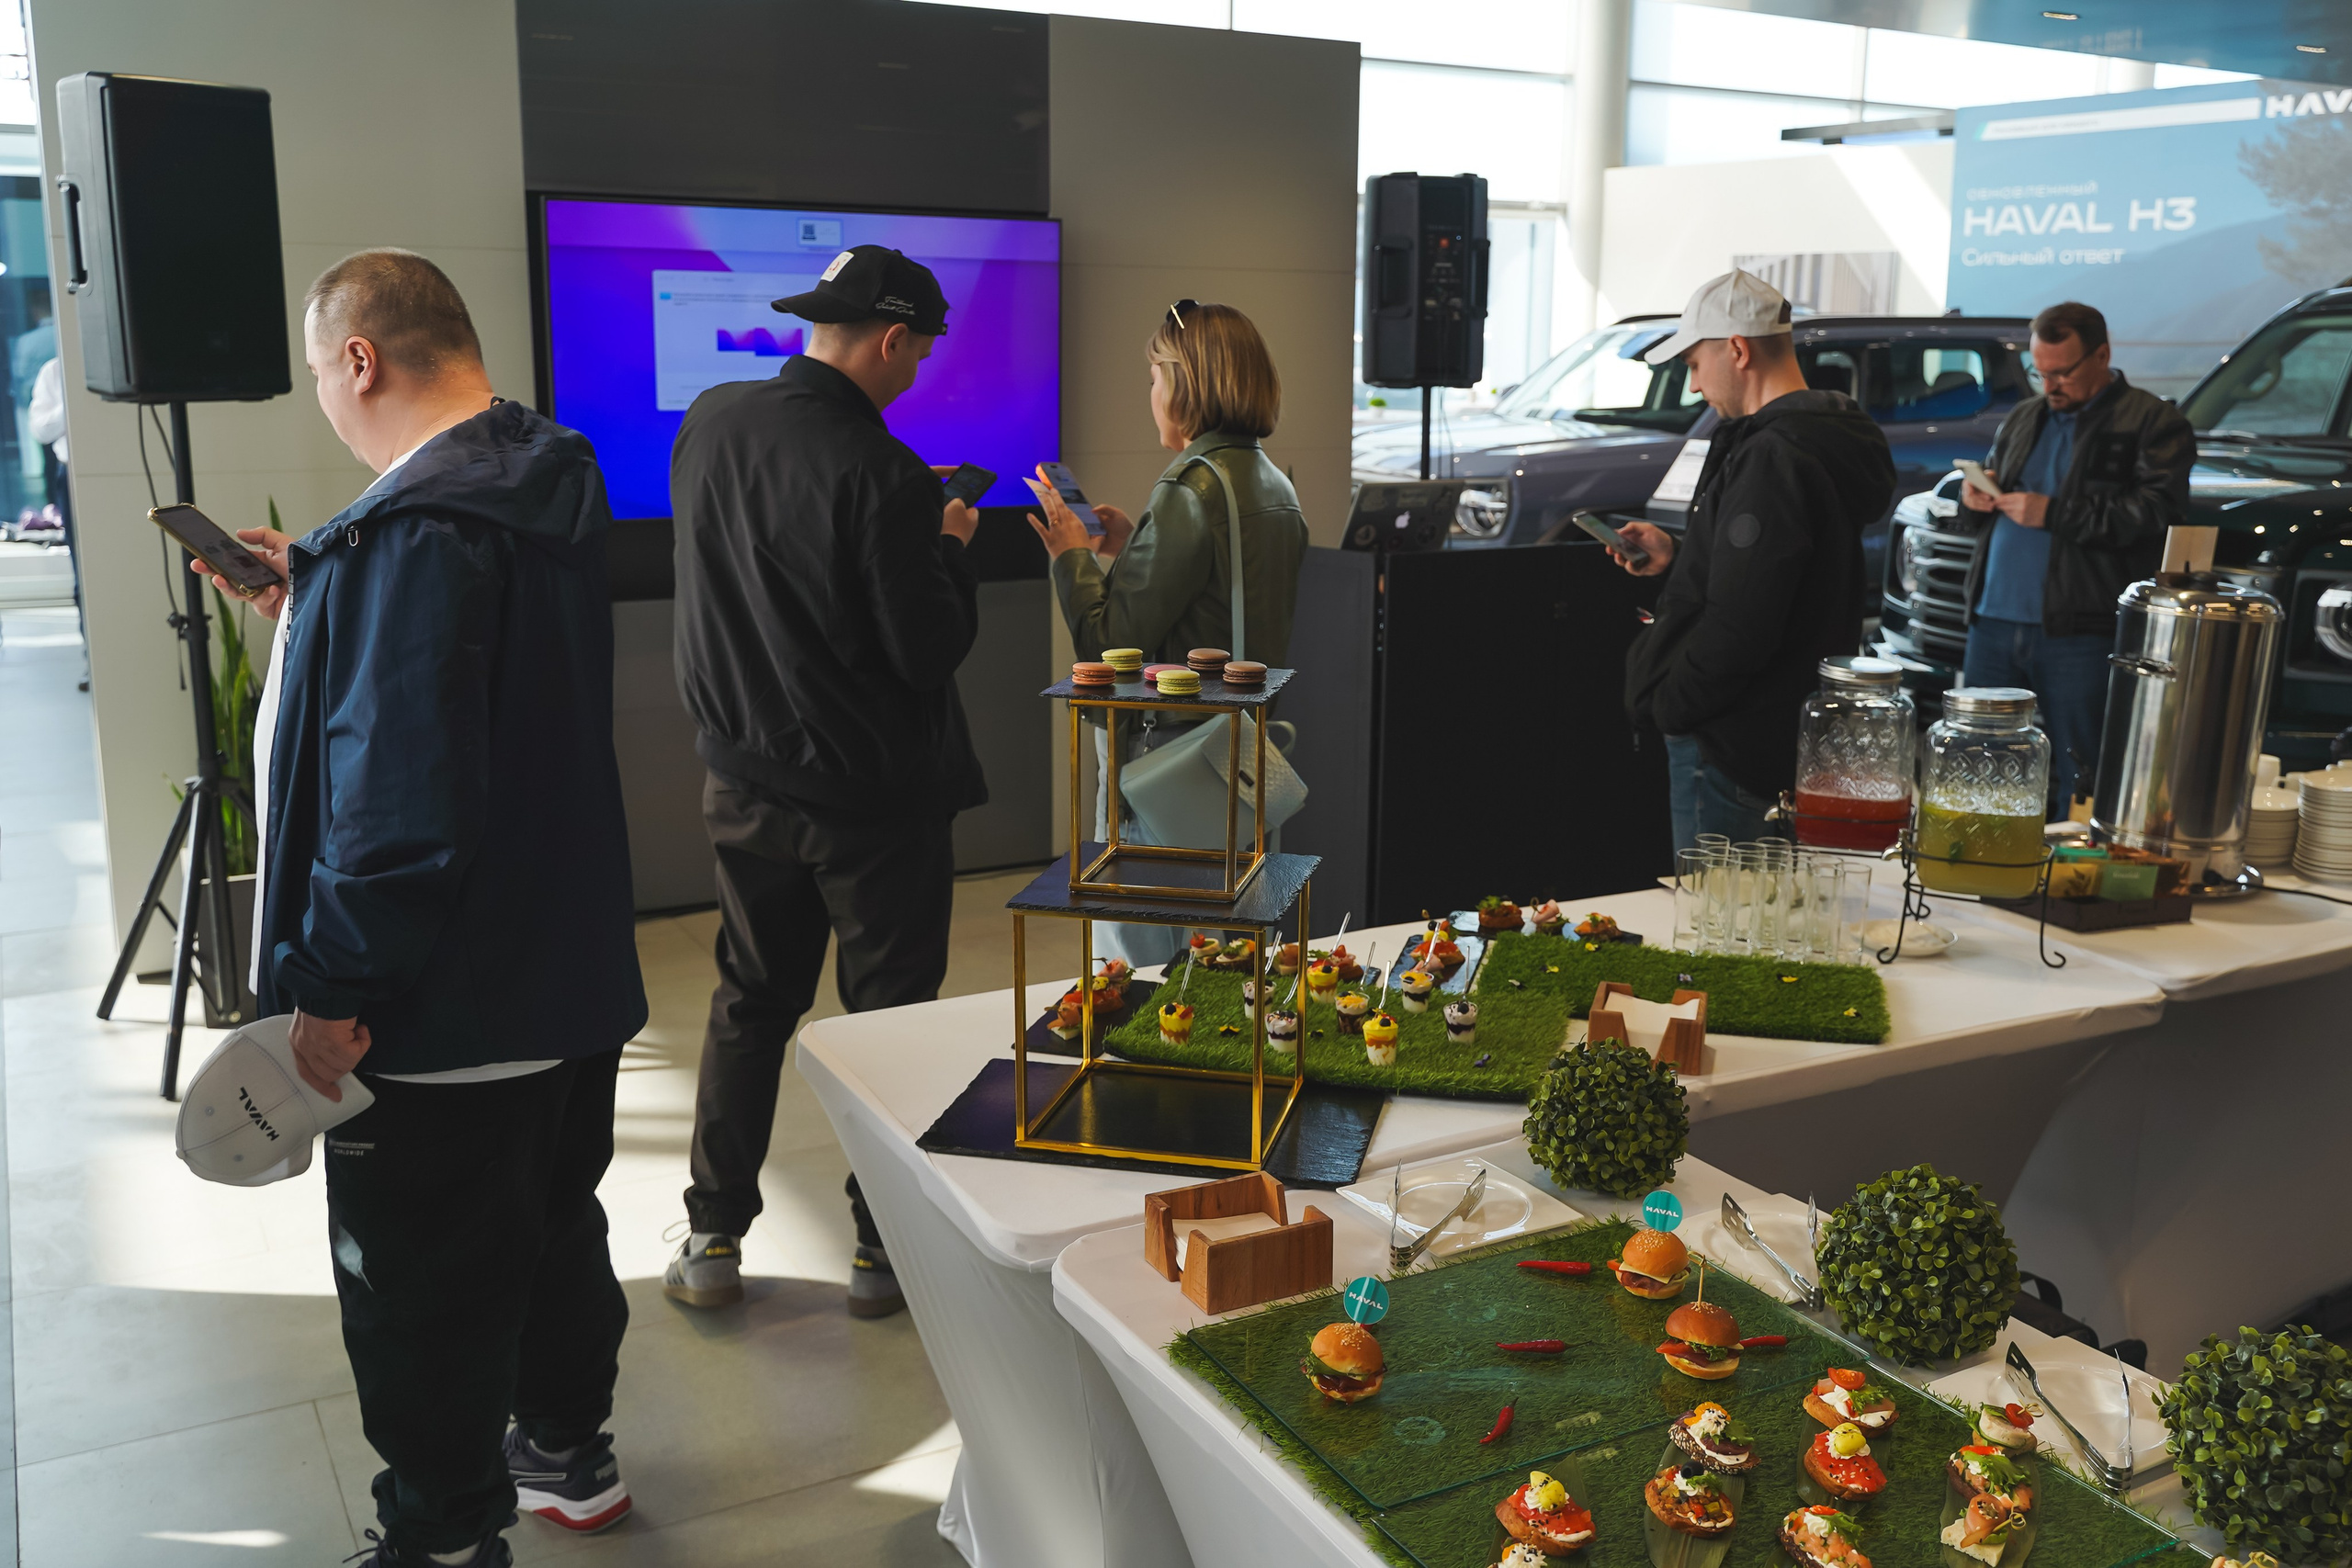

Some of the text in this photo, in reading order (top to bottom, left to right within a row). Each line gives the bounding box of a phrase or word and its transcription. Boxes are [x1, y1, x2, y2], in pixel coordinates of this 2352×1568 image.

[2265, 89, 2352, 118] HAV
[1962, 196, 2197, 237] HAVAL H3
[1961, 246, 2054, 267] Сильный
[239, 1086, 280, 1141] HAVAL
[1645, 1205, 1679, 1218] HAVAL
[1348, 1292, 1384, 1310] HAVAL
